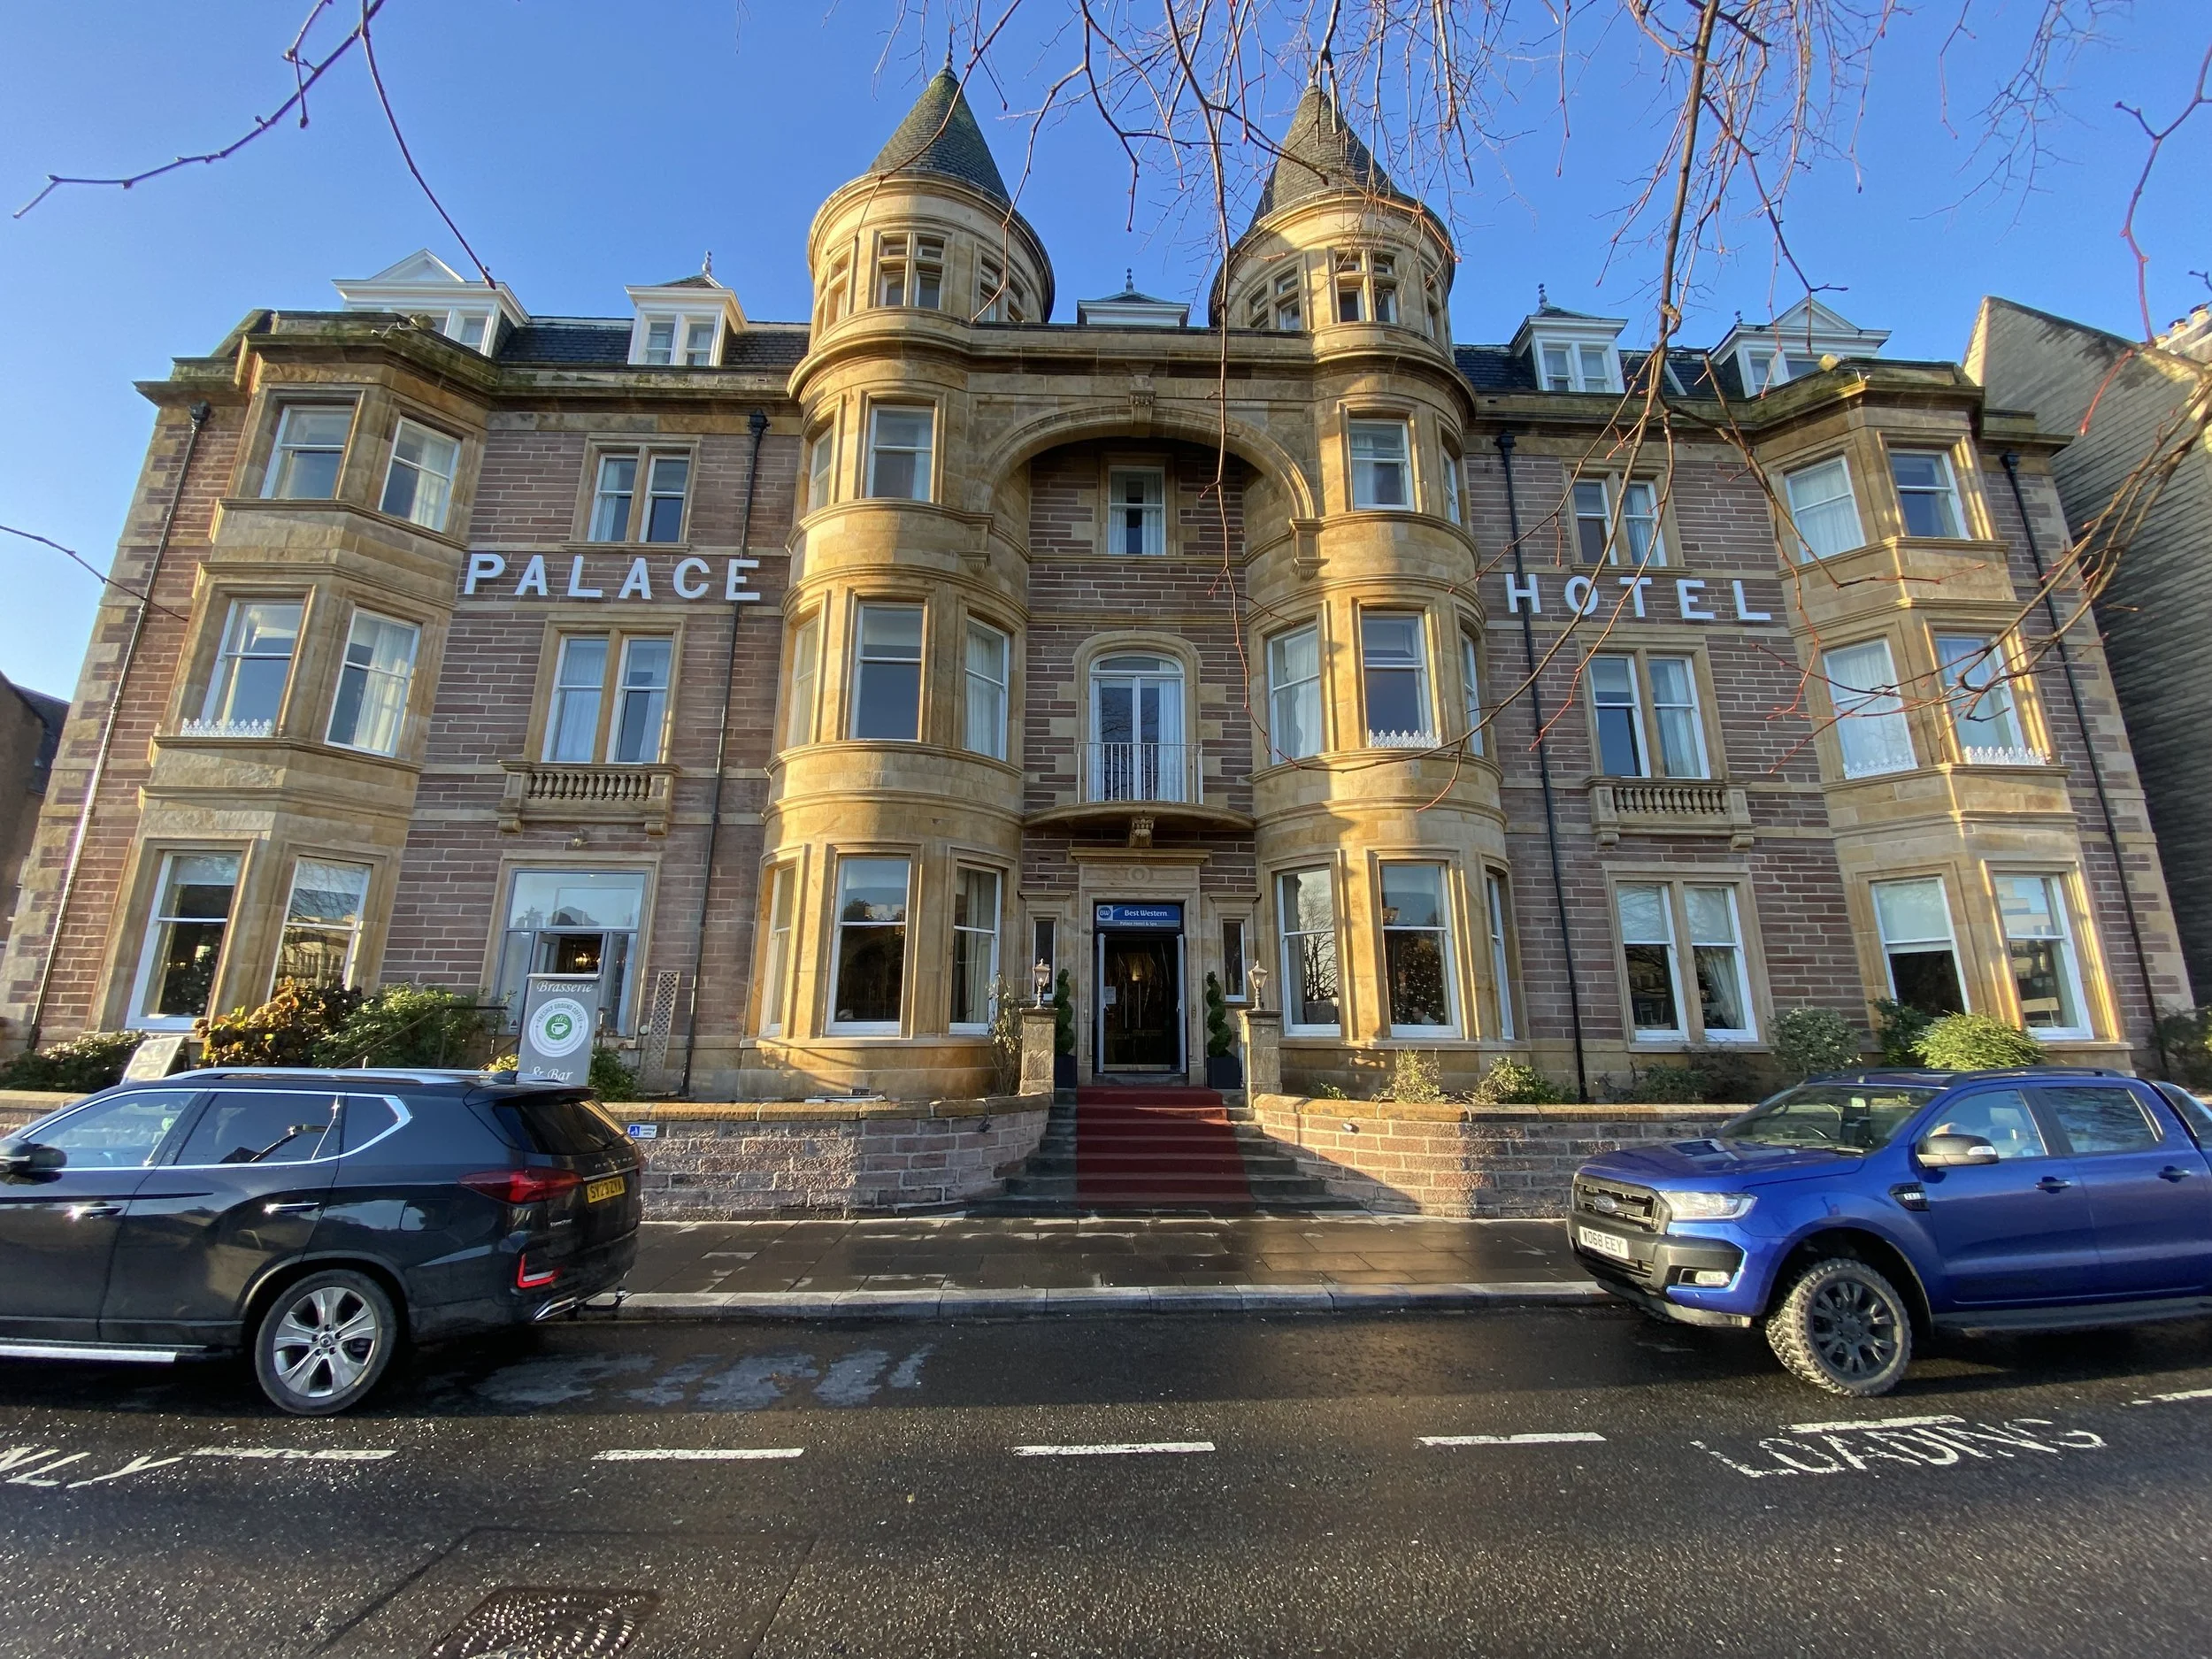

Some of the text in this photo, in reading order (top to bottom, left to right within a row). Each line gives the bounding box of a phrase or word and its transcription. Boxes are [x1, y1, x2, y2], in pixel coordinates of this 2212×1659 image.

[464, 553, 761, 601] PALACE
[1505, 573, 1772, 620] HOTEL
[536, 980, 594, 993] Brasserie
[533, 1066, 574, 1081] & Bar
[1604, 1237, 1624, 1254] EEY
[1690, 1418, 2108, 1478] LOADING
